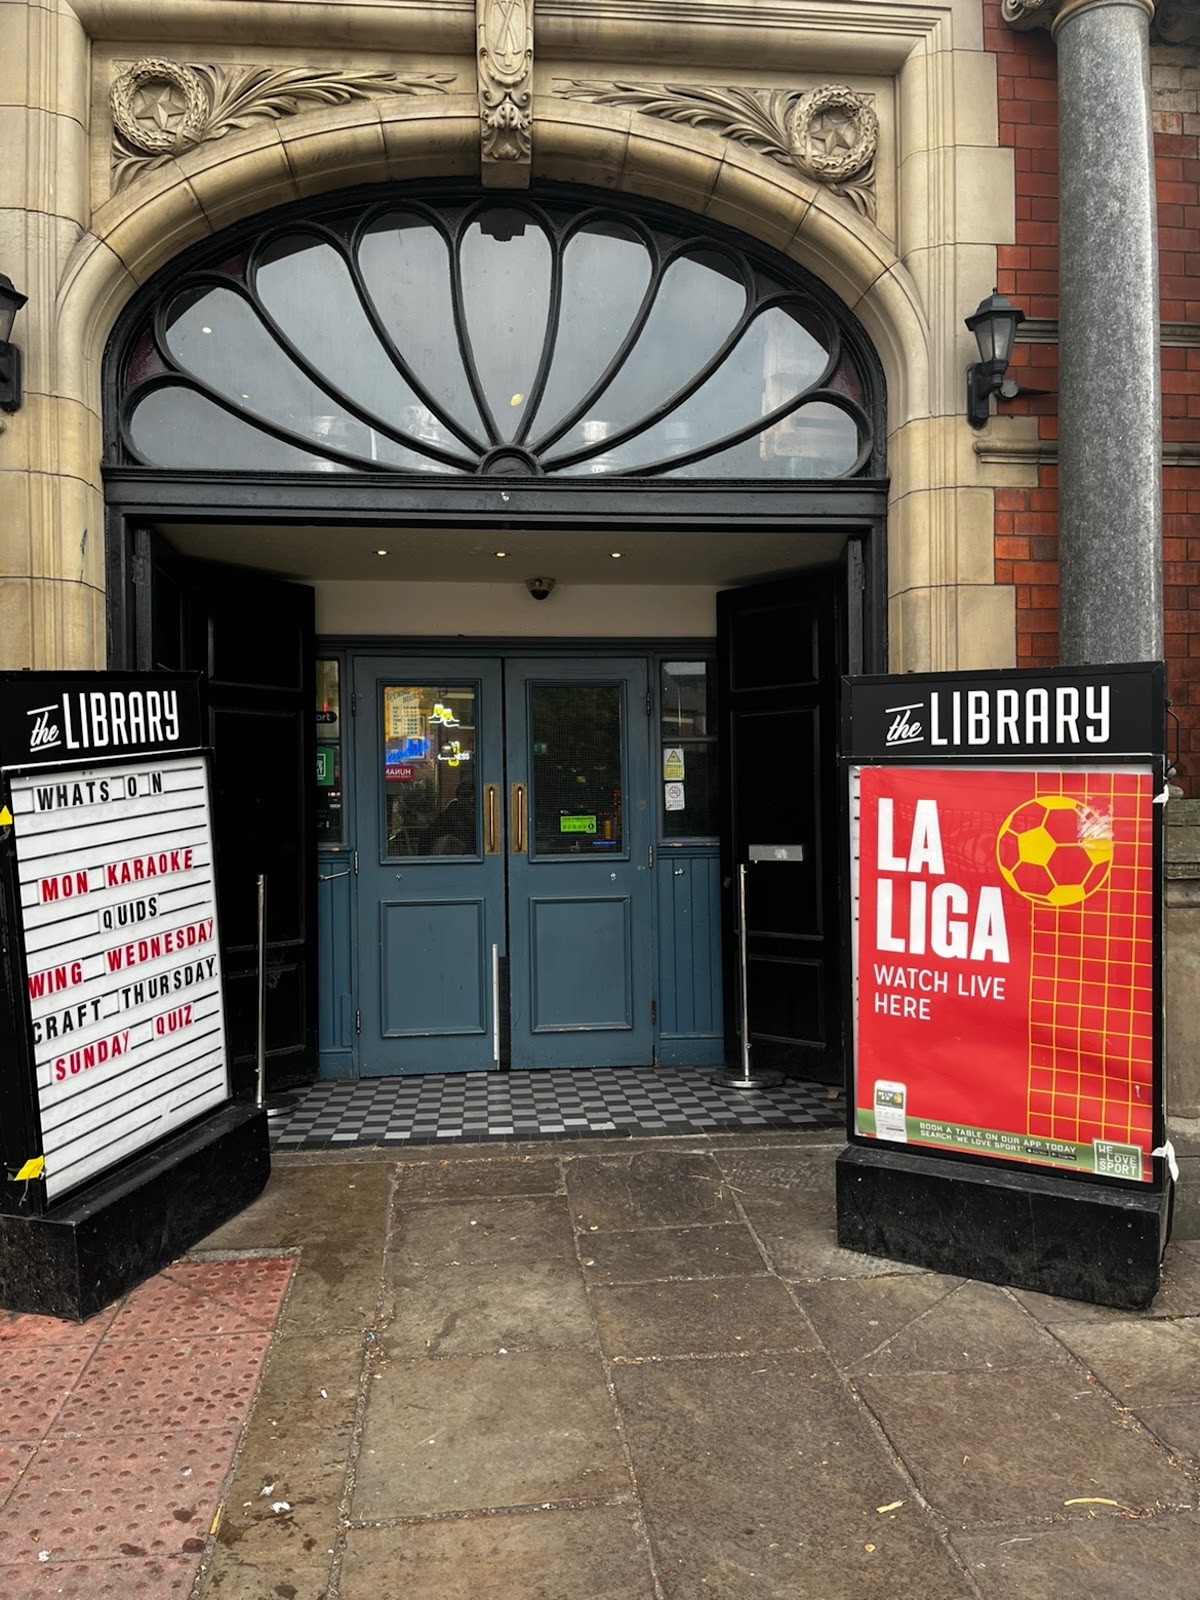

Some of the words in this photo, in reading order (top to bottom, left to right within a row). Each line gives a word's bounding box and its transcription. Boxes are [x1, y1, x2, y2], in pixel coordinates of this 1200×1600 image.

[30, 711, 59, 747] the
[62, 690, 180, 749] LIBRARY
[886, 709, 922, 742] the
[930, 685, 1110, 746] LIBRARY
[37, 780, 110, 811] WHATS
[877, 797, 945, 875] LA
[41, 871, 89, 903] MON
[107, 849, 193, 887] KARAOKE
[103, 897, 158, 929] QUIDS
[876, 878, 1010, 964] LIGA
[27, 962, 83, 999] WING
[107, 919, 214, 972] WEDNESDAY
[873, 963, 948, 993] WATCH
[958, 973, 1006, 1000] LIVE
[33, 999, 101, 1045] CRAFT
[122, 958, 216, 1009] THURSDAY
[875, 992, 931, 1020] HERE
[55, 1031, 130, 1081] SUNDAY
[156, 1004, 193, 1036] QUIZ
[919, 1122, 943, 1132] BOOK
[955, 1128, 982, 1138] TABLE
[985, 1133, 998, 1141] ON
[1001, 1135, 1020, 1144] OUR
[1023, 1139, 1041, 1148] APP
[1045, 1142, 1076, 1153] TODAY
[920, 1130, 952, 1140] SEARCH
[971, 1138, 992, 1147] LOVE
[1098, 1144, 1113, 1155] WE
[1099, 1160, 1137, 1176] SPORT
[1106, 1154, 1137, 1166] LOVE
